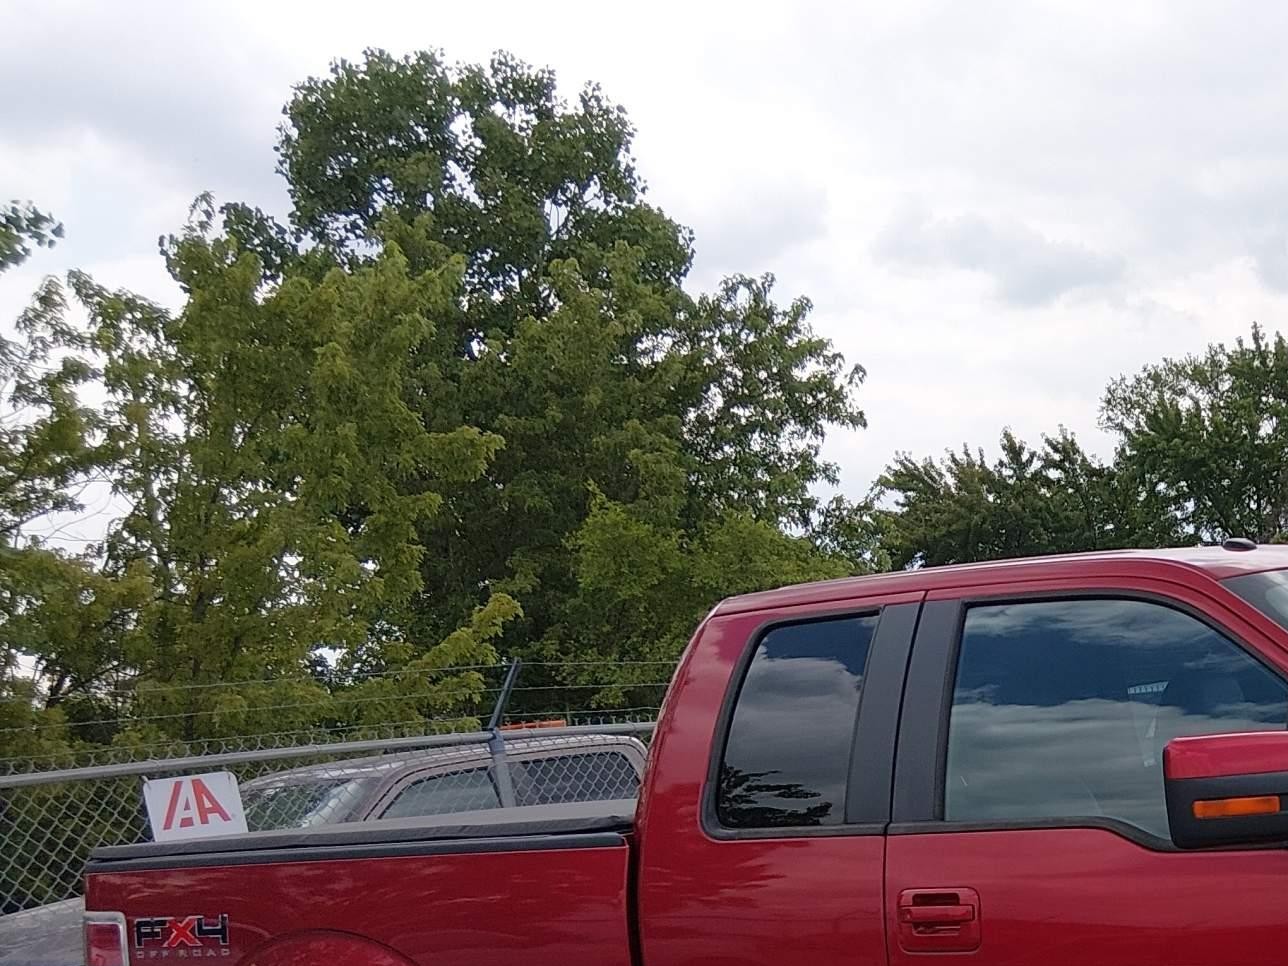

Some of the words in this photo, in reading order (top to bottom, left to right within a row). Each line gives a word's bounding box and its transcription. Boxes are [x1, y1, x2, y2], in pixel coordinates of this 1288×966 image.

[134, 914, 229, 948] FX4
[136, 950, 169, 959] OFF
[179, 948, 230, 957] ROAD
